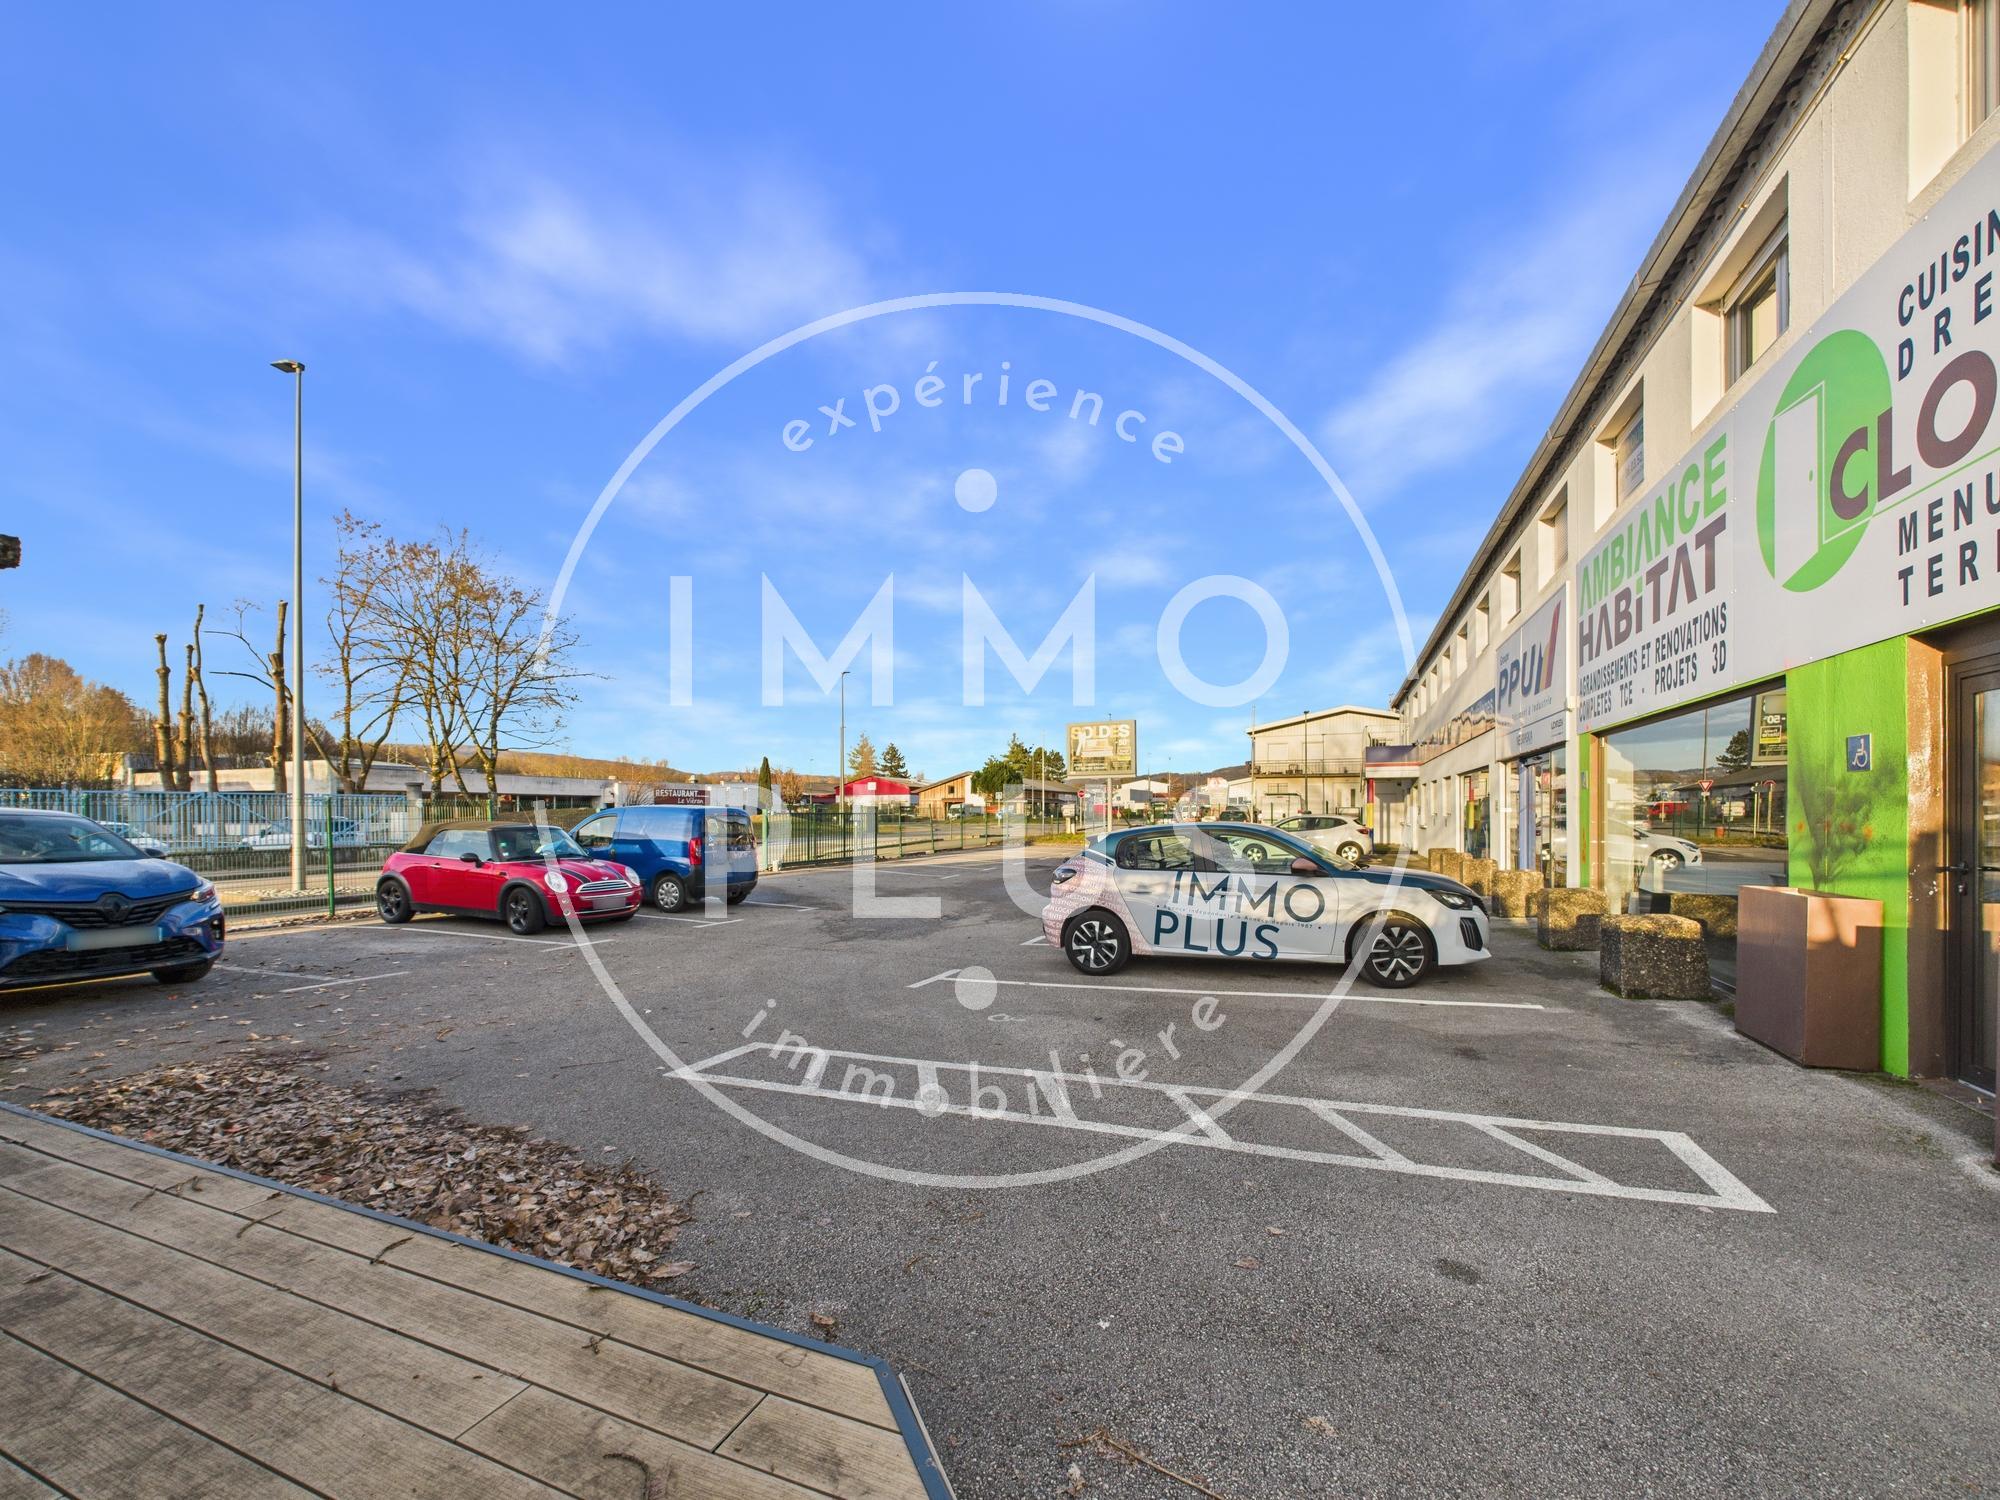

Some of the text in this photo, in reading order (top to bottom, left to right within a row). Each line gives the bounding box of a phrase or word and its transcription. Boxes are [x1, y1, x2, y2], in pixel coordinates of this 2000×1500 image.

[1829, 350, 1998, 521] CLO
[1580, 432, 1727, 616] AMBIANCE
[1898, 529, 2000, 606] TER
[1579, 601, 1727, 697] AGRANDISSEMENTS ET RENOVATIONS
[1619, 680, 1633, 709] TCE
[1654, 652, 1698, 696] PROJETS
[1712, 639, 1727, 675] 3D
[655, 789, 699, 798] RESTAURANT
[1172, 871, 1326, 923] IMMO
[1153, 909, 1281, 960] PLUS
